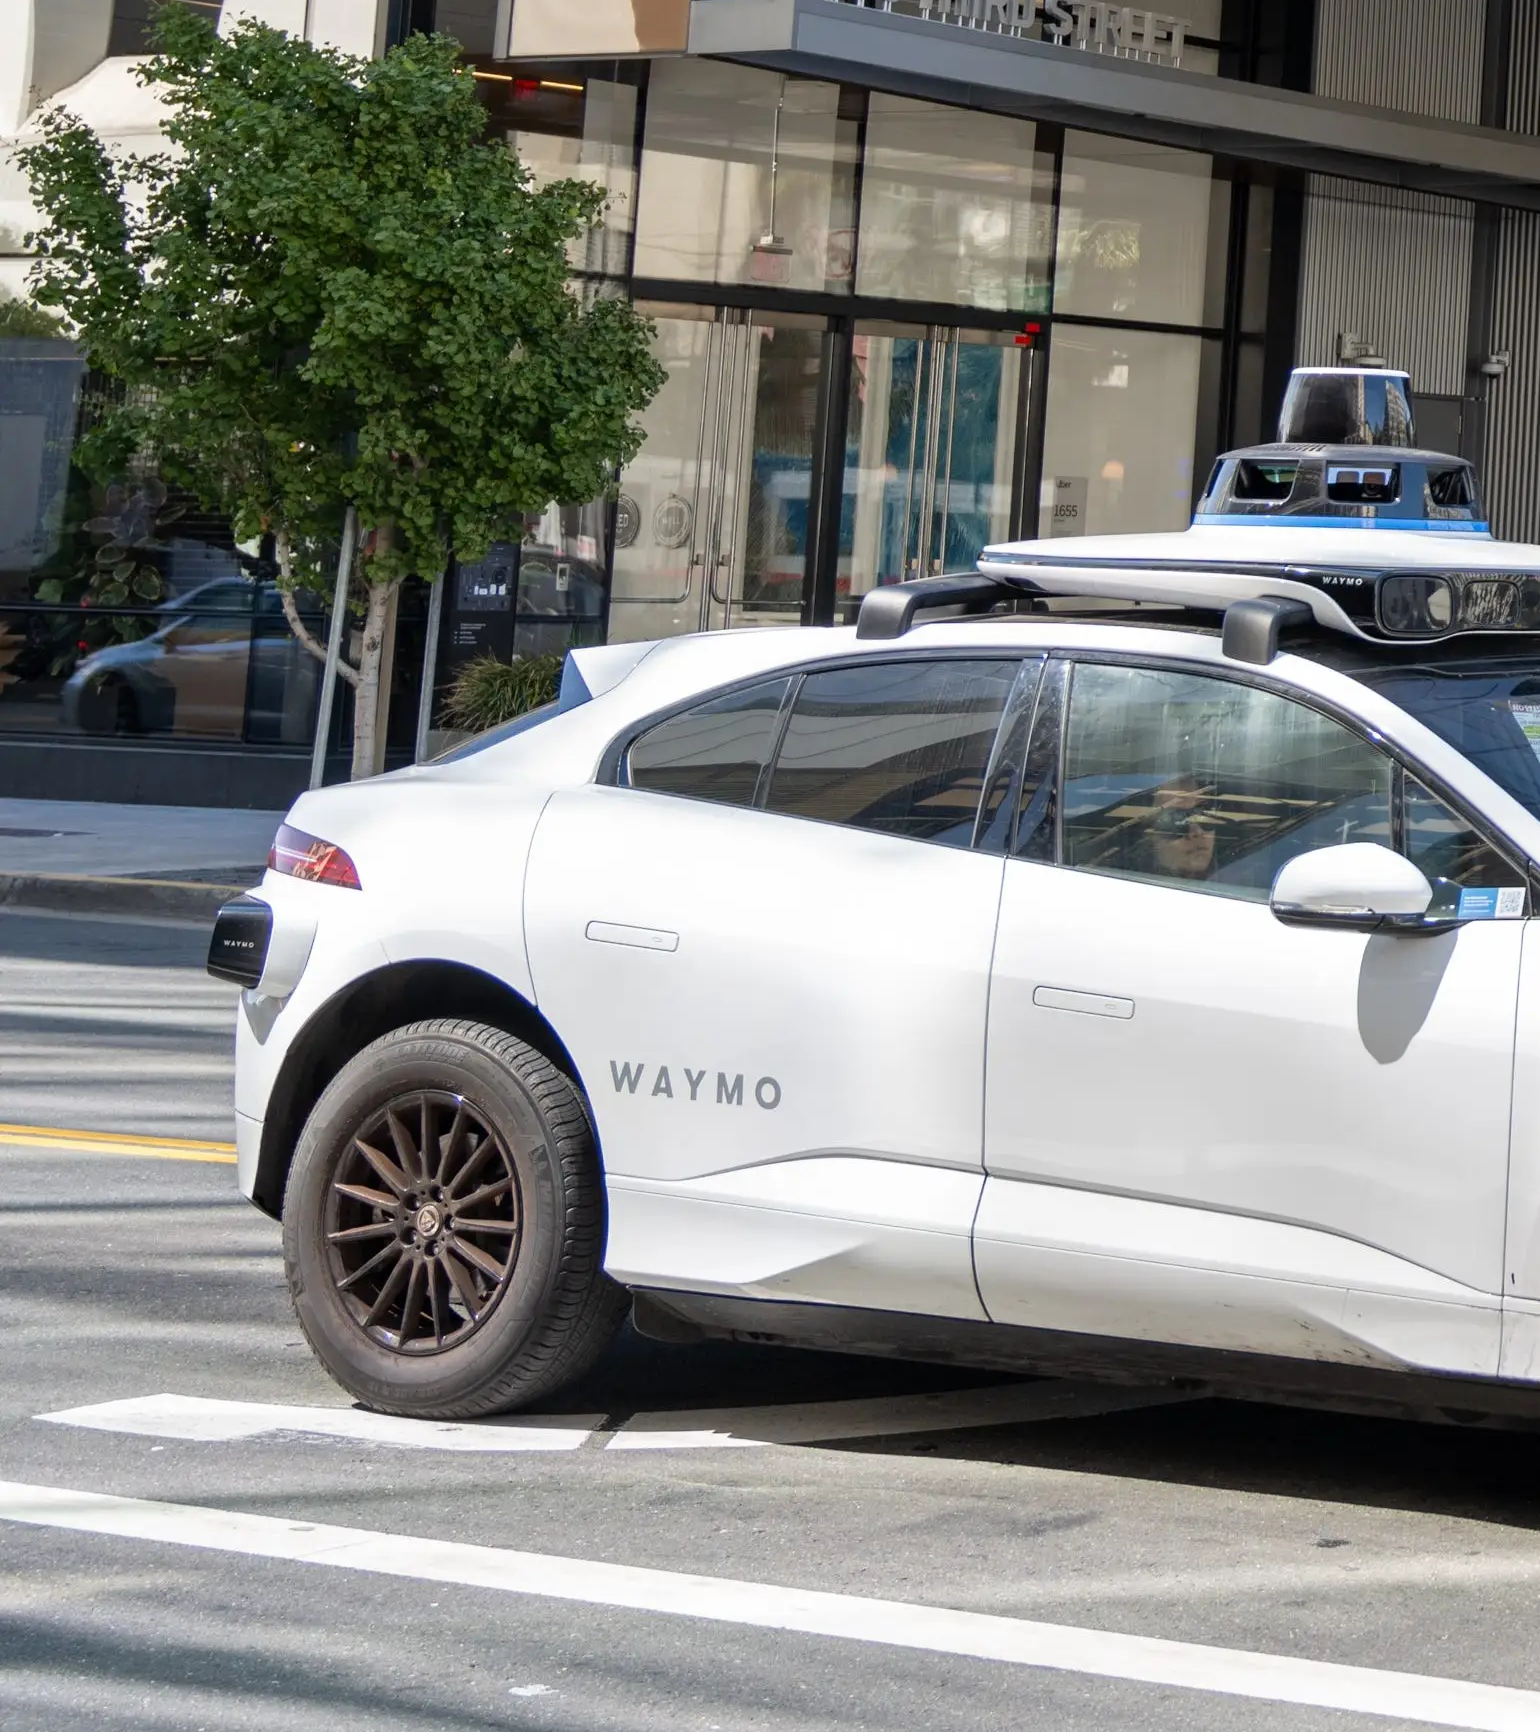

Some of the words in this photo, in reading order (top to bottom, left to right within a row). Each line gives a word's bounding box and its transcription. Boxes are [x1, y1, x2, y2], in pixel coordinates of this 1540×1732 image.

[1054, 504, 1078, 517] 1655
[1322, 576, 1363, 586] WAYMO
[223, 939, 255, 948] WAYMO
[609, 1059, 782, 1110] WAYMO
